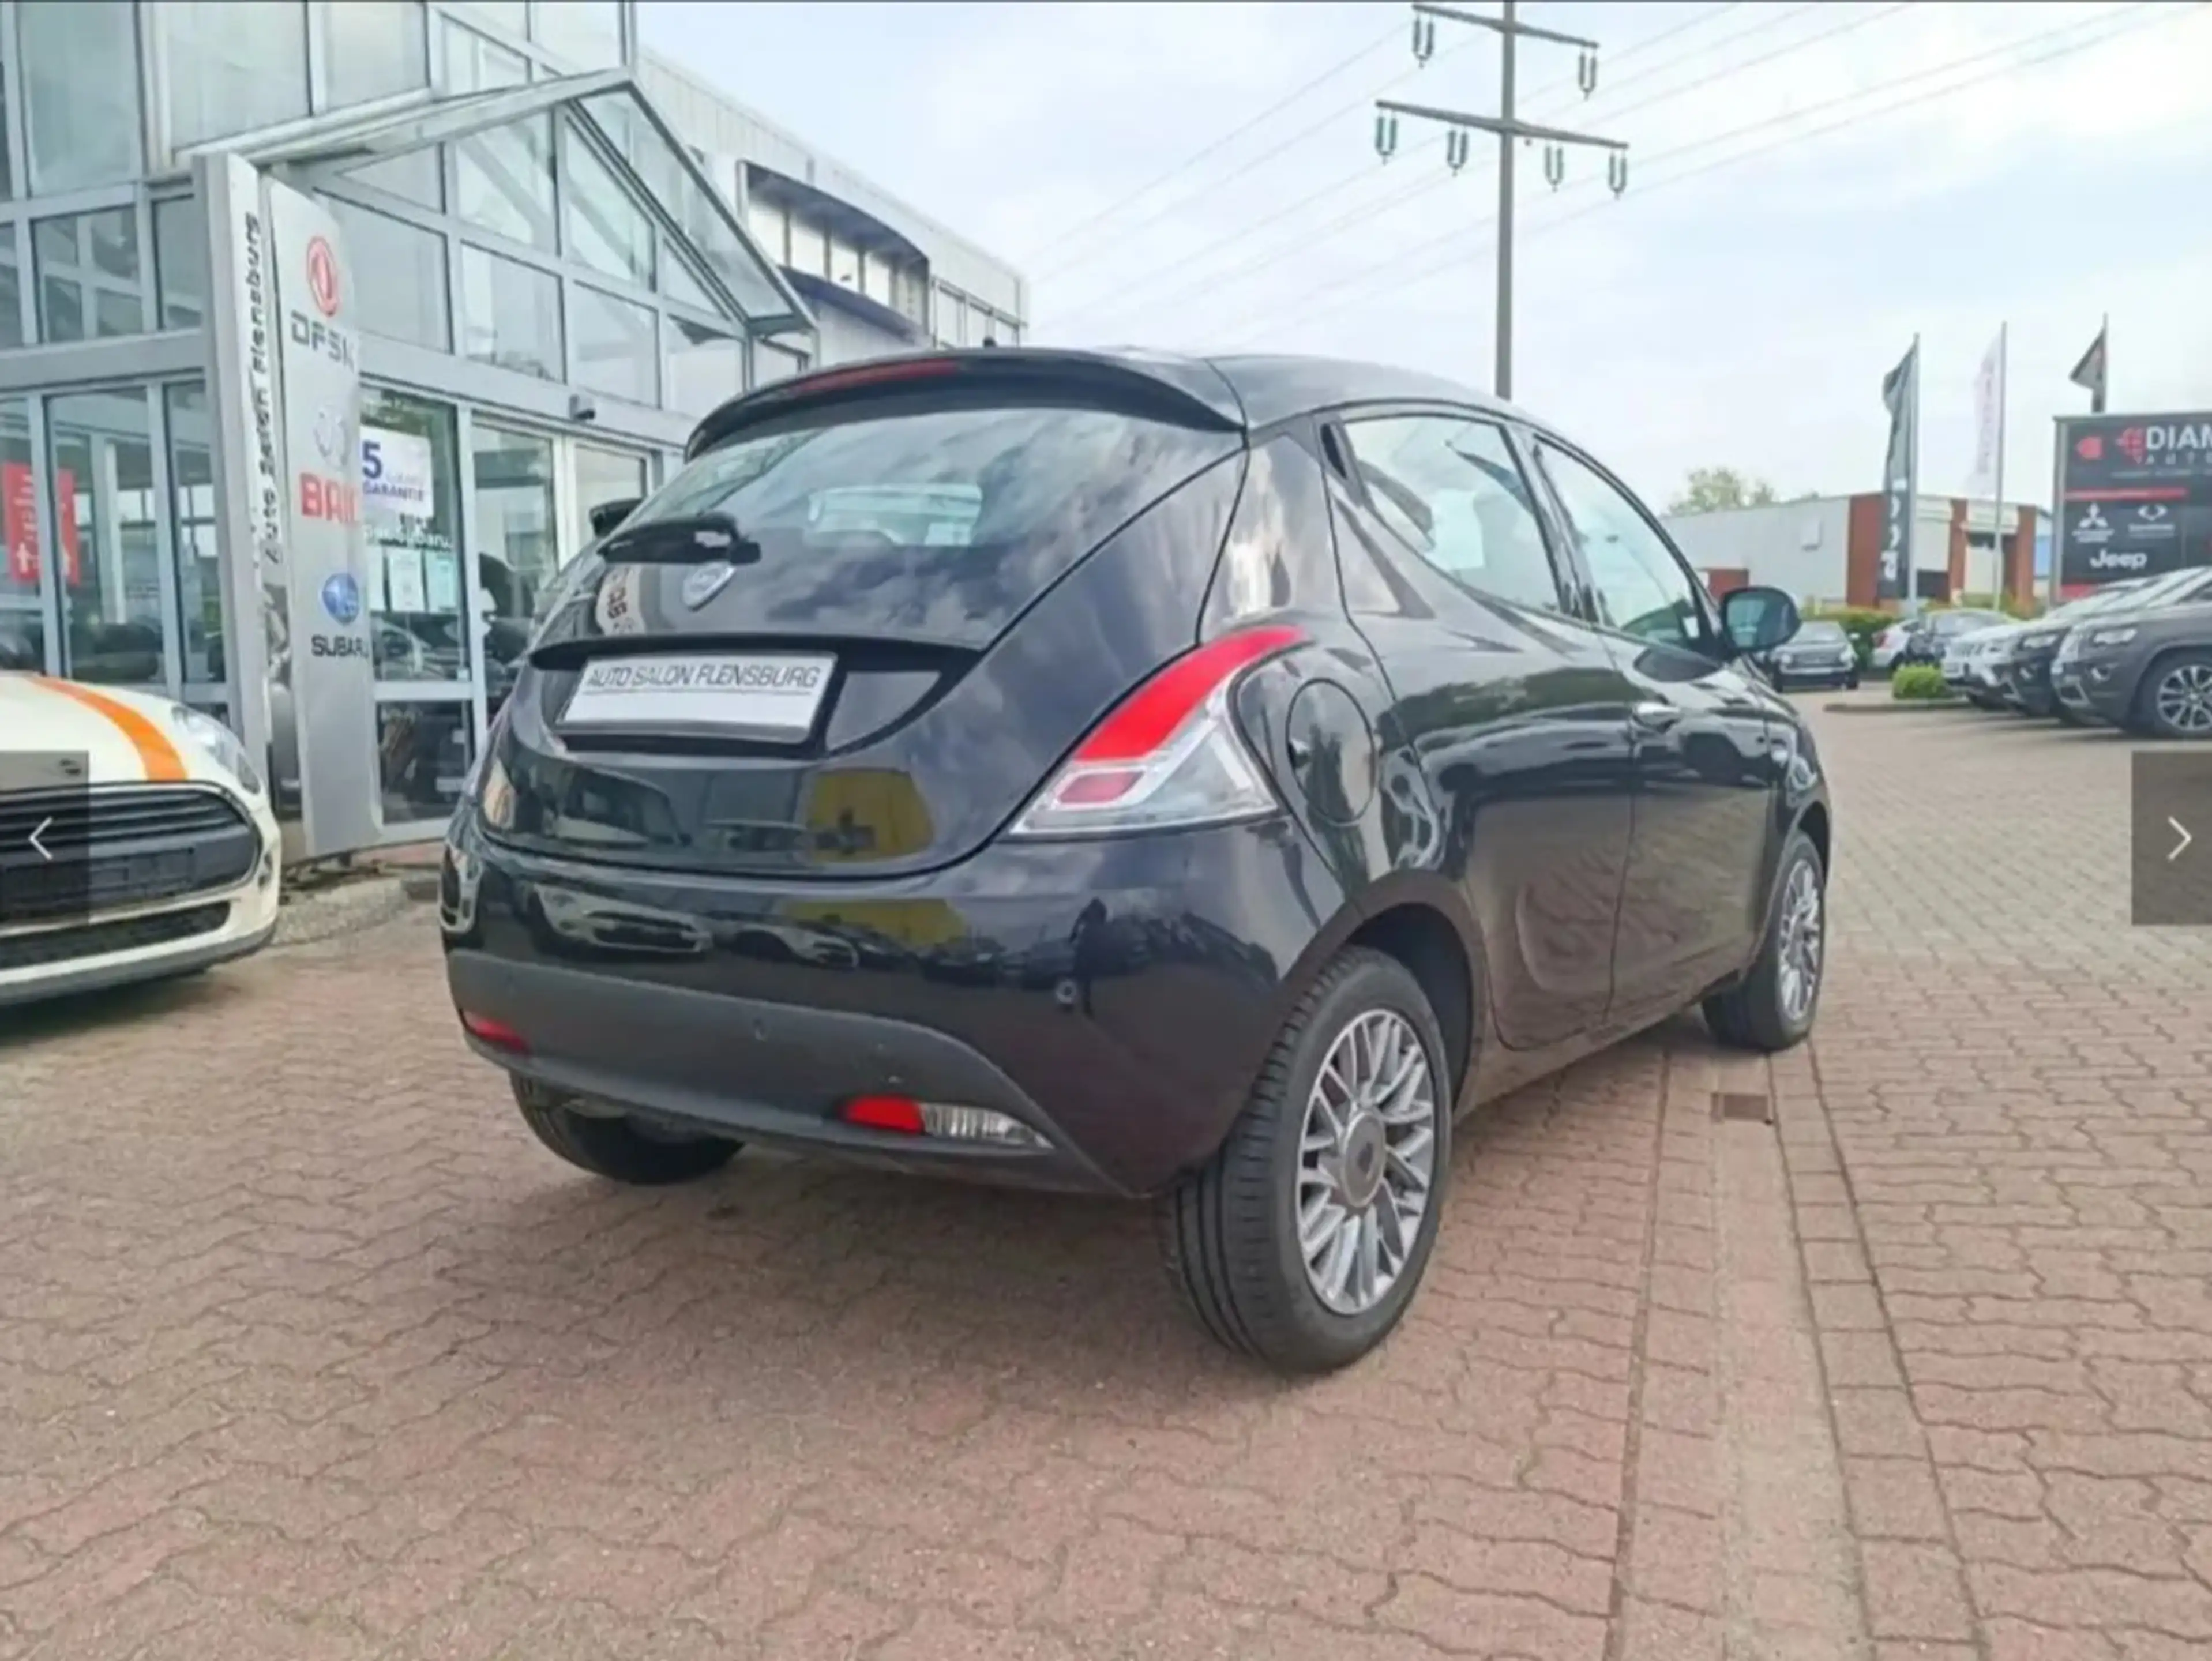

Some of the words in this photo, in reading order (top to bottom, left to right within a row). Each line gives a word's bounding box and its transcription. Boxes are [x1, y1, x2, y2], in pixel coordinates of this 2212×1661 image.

[245, 211, 266, 374] Flensburg
[362, 440, 382, 479] 5
[2089, 548, 2147, 569] Jeep
[587, 666, 632, 686] AUTO
[632, 665, 692, 686] SALON
[693, 664, 821, 689] FLENSBURG
